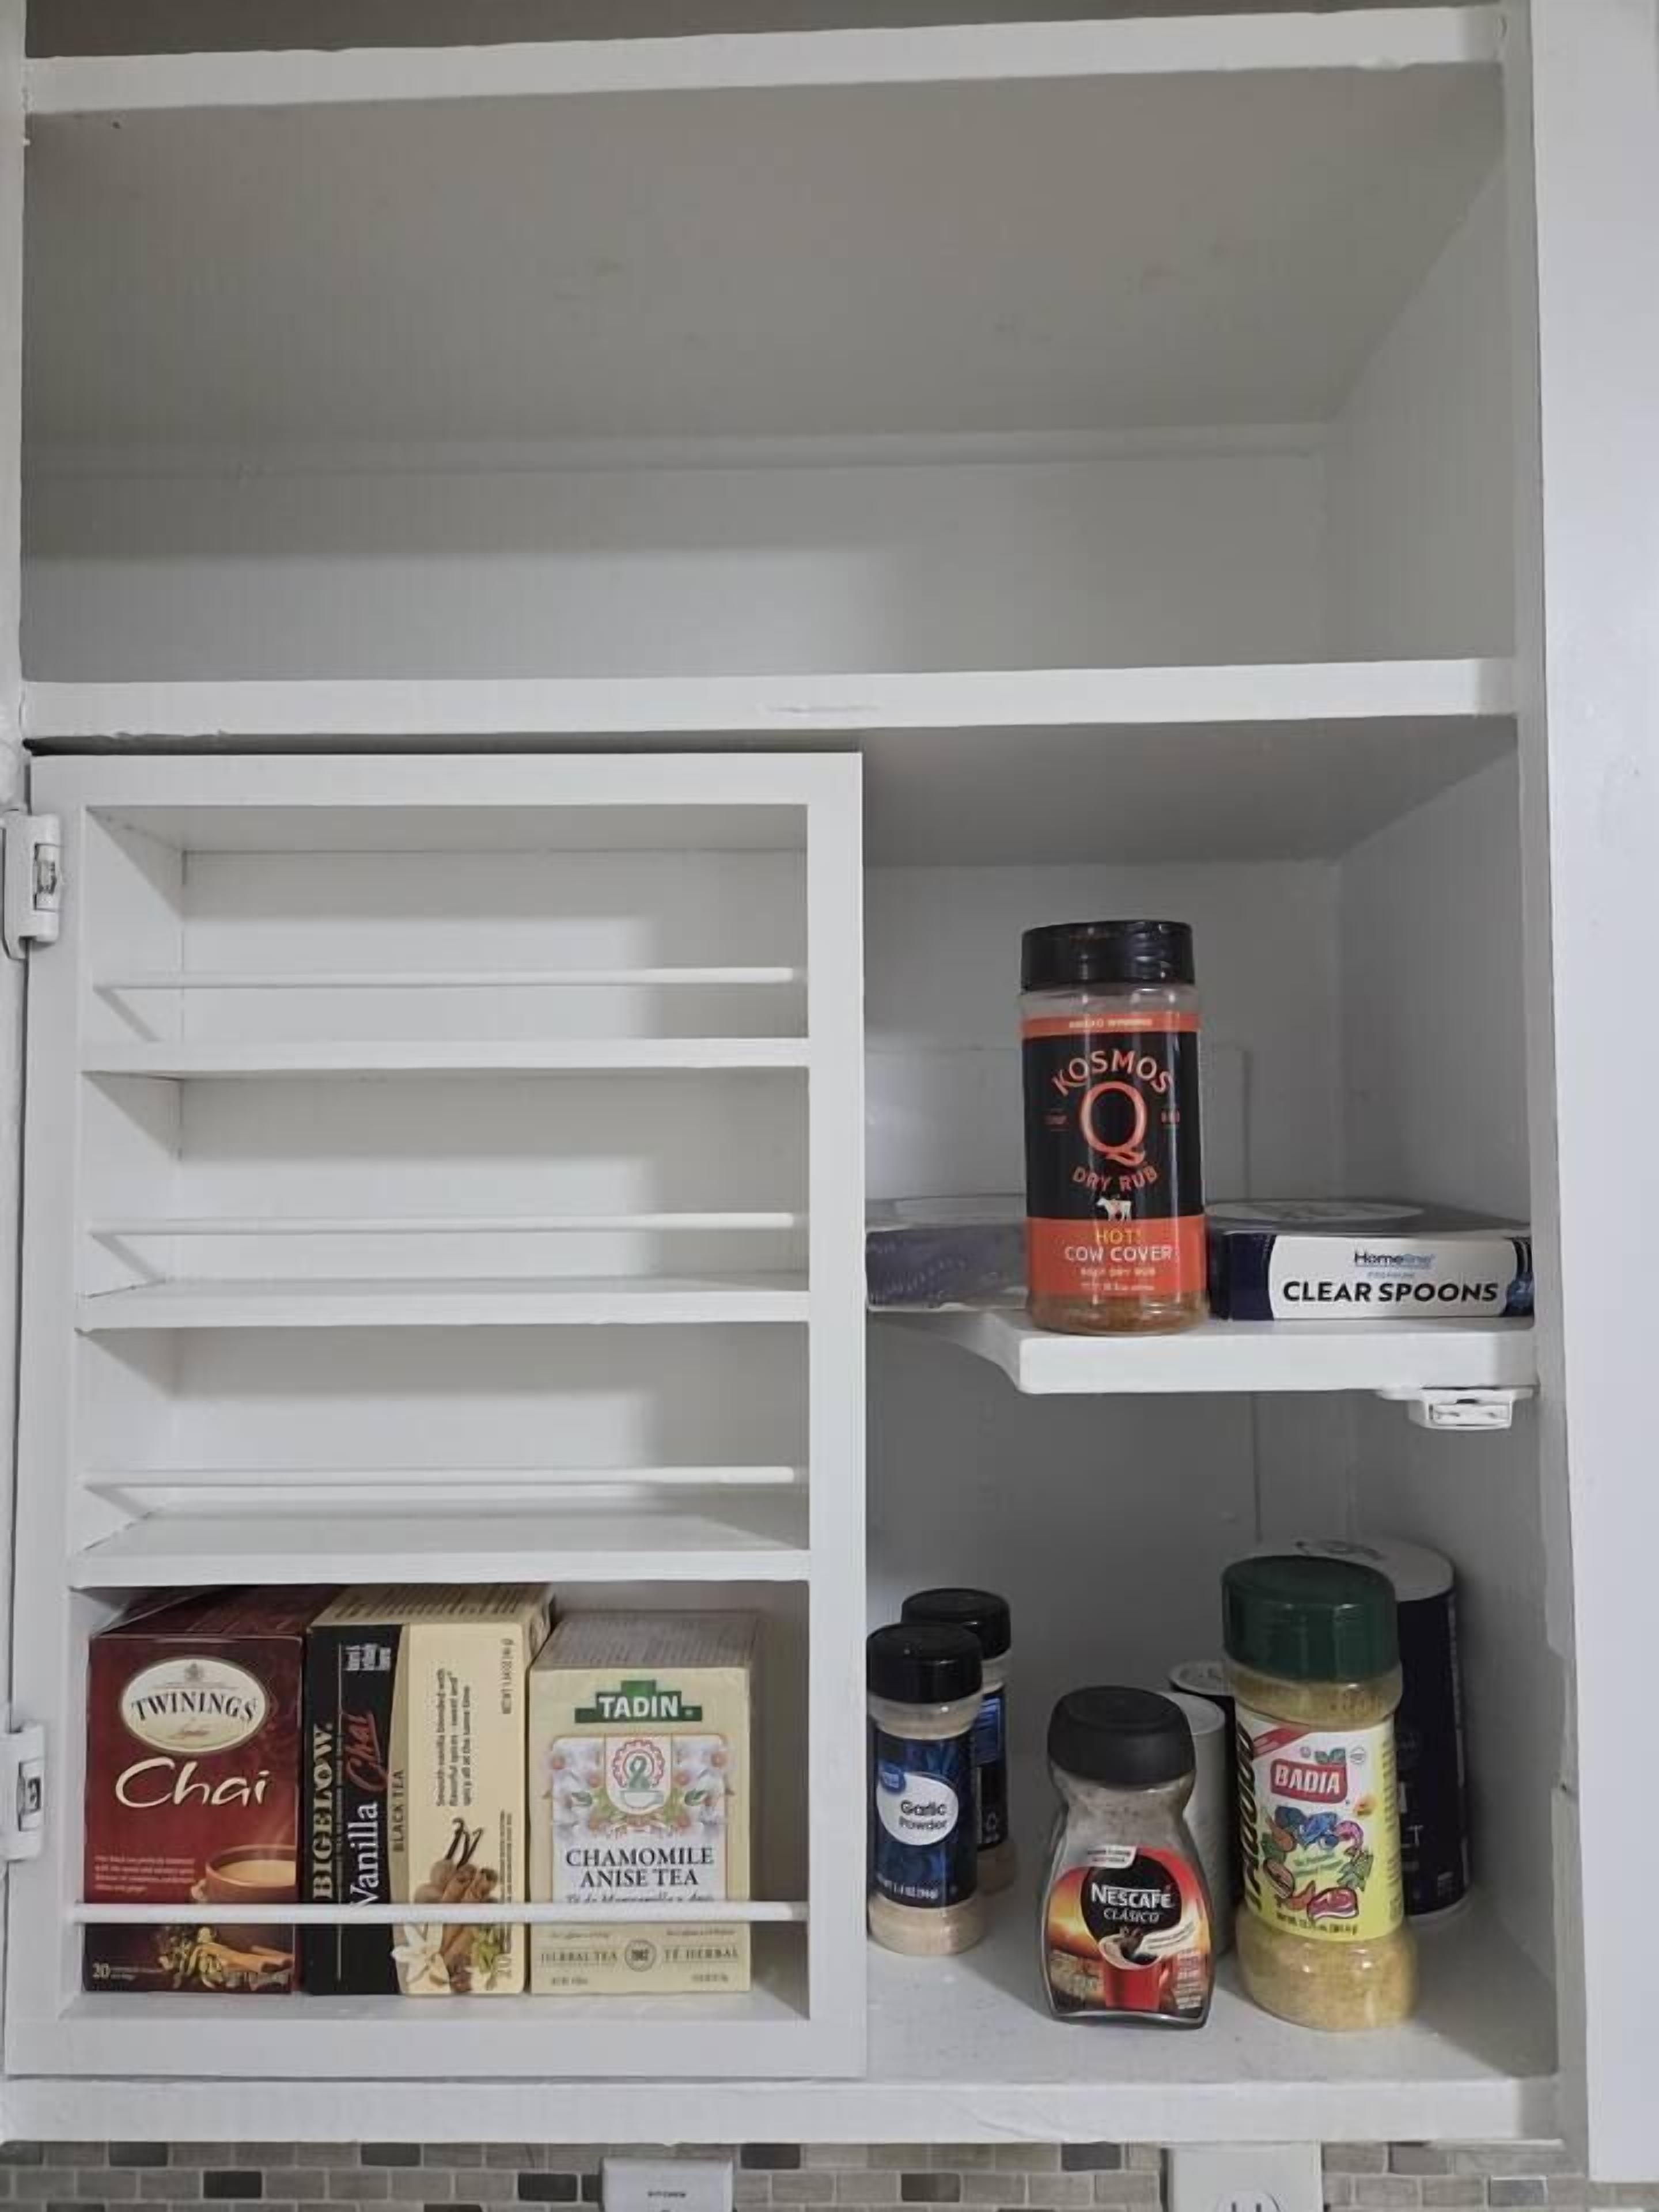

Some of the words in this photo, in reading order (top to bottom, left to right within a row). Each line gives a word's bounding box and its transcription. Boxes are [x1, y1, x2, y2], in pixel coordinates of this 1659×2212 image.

[1052, 1048, 1173, 1097] KOSMOS
[1080, 1080, 1147, 1166] Q
[1072, 1166, 1112, 1192] DRY
[1118, 1165, 1158, 1191] RUB
[1065, 1245, 1104, 1262] COW
[1109, 1245, 1173, 1262] COVER
[1283, 1281, 1372, 1302] CLEAR
[1378, 1282, 1498, 1302] SPOONS
[131, 1691, 258, 1722] TWININGS
[599, 1695, 680, 1718] TADIN
[345, 1711, 389, 1793] Chai
[115, 1756, 271, 1809] Chai
[392, 1769, 404, 1800] TEA
[1275, 1764, 1340, 1794] BADIA
[312, 1728, 334, 1900] BIGELOW
[899, 1816, 948, 1830] Powder
[900, 1800, 948, 1816] Garlic
[392, 1804, 404, 1851] BLACK
[350, 1801, 379, 1906] Vanilla
[566, 1847, 715, 1867] CHAMOMILE
[581, 1869, 648, 1888] ANISE
[652, 1868, 699, 1887] TEA
[1091, 1882, 1174, 1909] NESCAFÉ
